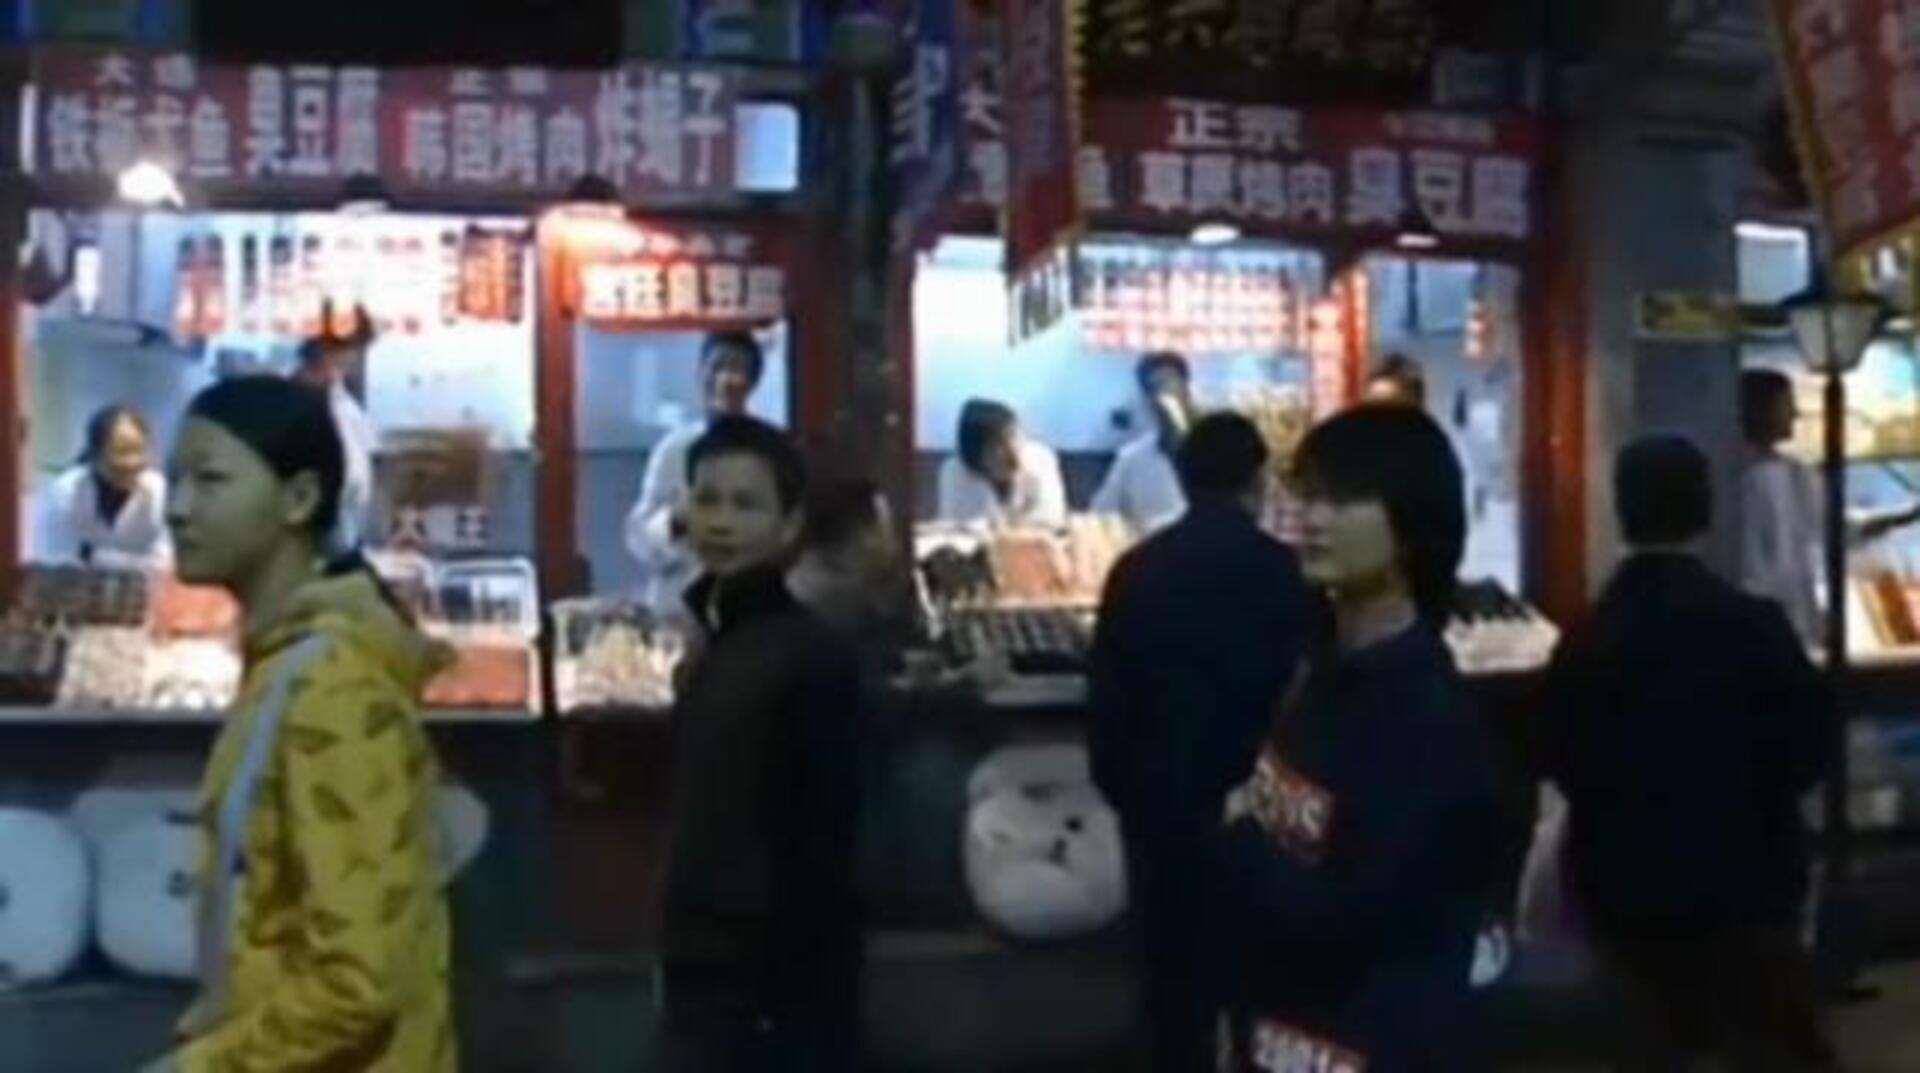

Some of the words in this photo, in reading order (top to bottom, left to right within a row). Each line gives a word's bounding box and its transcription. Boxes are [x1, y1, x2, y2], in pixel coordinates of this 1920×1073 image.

[243, 63, 380, 177] 臭豆腐
[403, 102, 587, 186] 韩国烤肉
[1165, 98, 1302, 153] 正宗
[1345, 146, 1529, 238] 臭豆腐
